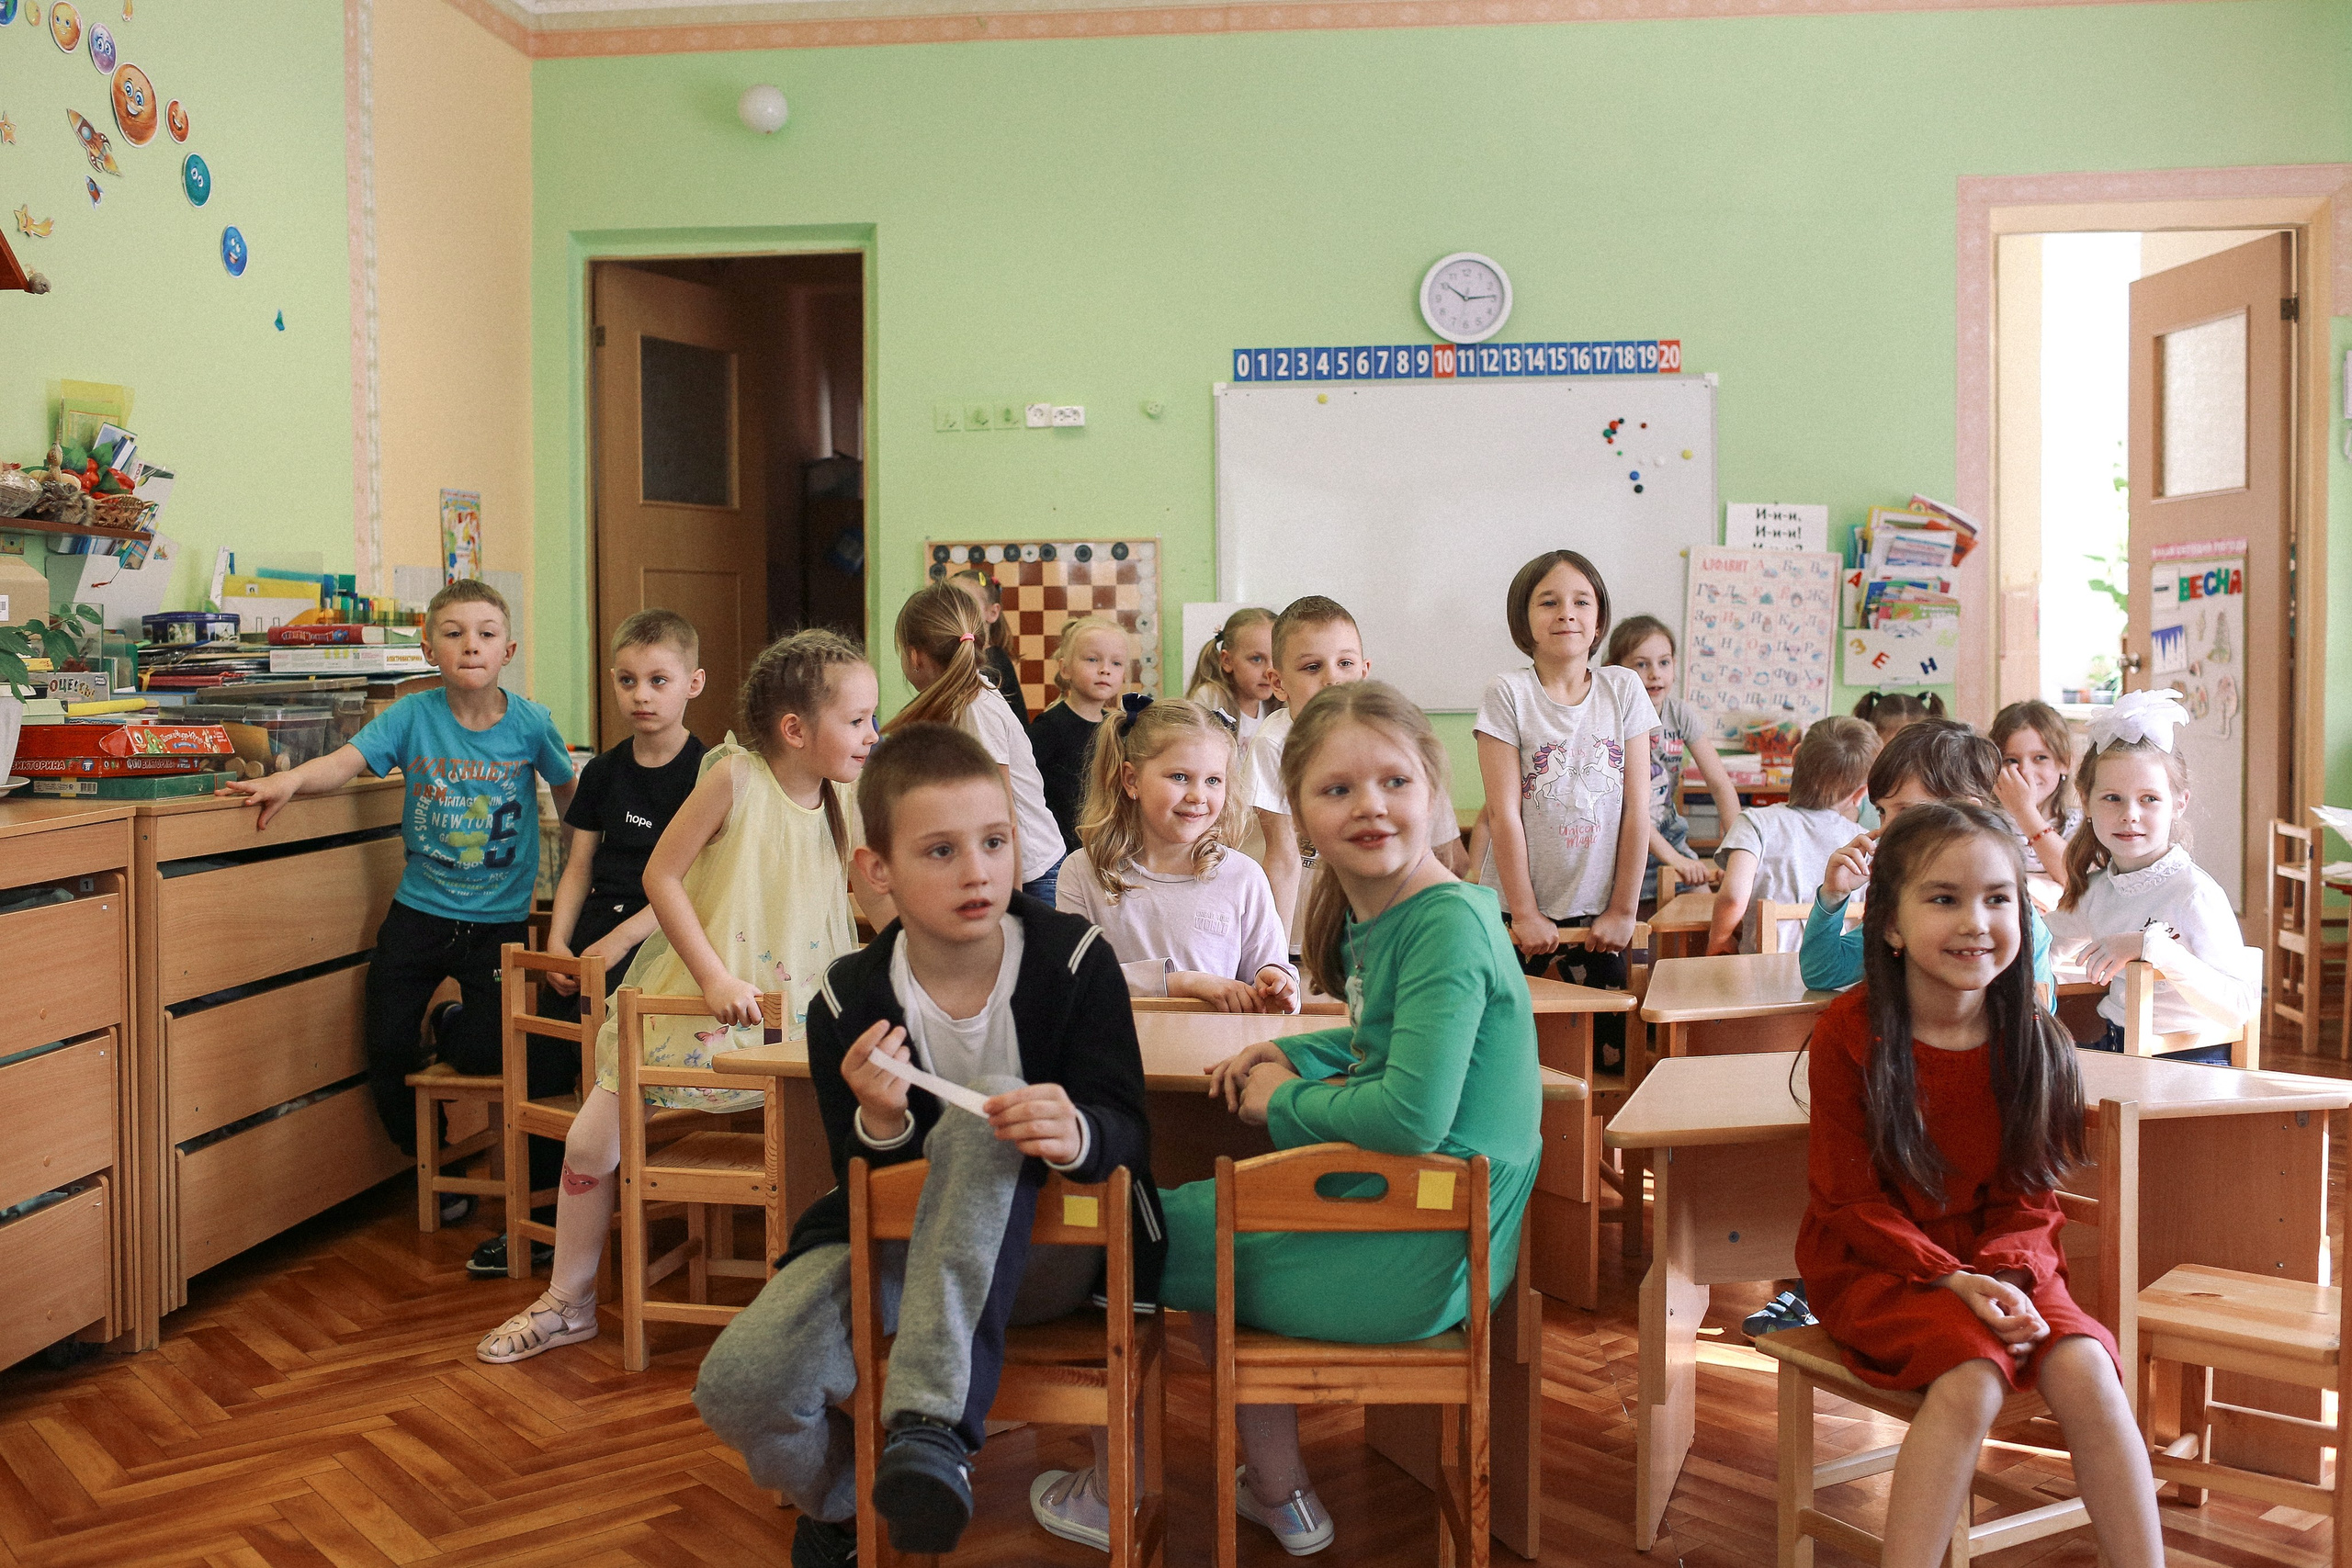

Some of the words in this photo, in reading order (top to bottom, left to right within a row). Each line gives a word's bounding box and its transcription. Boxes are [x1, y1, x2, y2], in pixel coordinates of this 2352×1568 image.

[1462, 268, 1472, 276] 12
[1435, 294, 1442, 303] 9
[1463, 321, 1469, 329] 6
[1476, 316, 1482, 325] 5
[1237, 354, 1250, 378] 0
[1258, 353, 1268, 377] 1
[1276, 353, 1289, 377] 2
[1296, 352, 1309, 377] 3
[1316, 352, 1329, 376] 4
[1336, 352, 1349, 376] 5
[1356, 351, 1369, 375] 6
[1377, 351, 1389, 375] 7
[1396, 350, 1409, 374] 8
[1417, 349, 1430, 374] 9
[1435, 349, 1453, 374] 10
[1457, 349, 1476, 373] 11
[1479, 348, 1499, 373] 12
[1502, 347, 1521, 372] 13
[1525, 347, 1545, 372] 14
[1548, 347, 1567, 371] 15
[1570, 346, 1590, 371] 16
[1593, 345, 1612, 370] 17
[1615, 345, 1635, 369] 18
[1637, 344, 1657, 369] 19
[1659, 344, 1680, 369] 20
[1848, 571, 1862, 588] А
[2178, 567, 2243, 603] ВЕСНА
[1871, 651, 1890, 670] Е
[1920, 657, 1938, 675] Н
[12, 760, 67, 771] ВИКТОРИНА
[438, 795, 480, 807] VINTAG
[432, 812, 464, 829] NEW
[467, 815, 494, 829] YOR
[625, 811, 652, 829] hope
[1558, 824, 1601, 836] Unicorn
[1566, 835, 1598, 850] Magic
